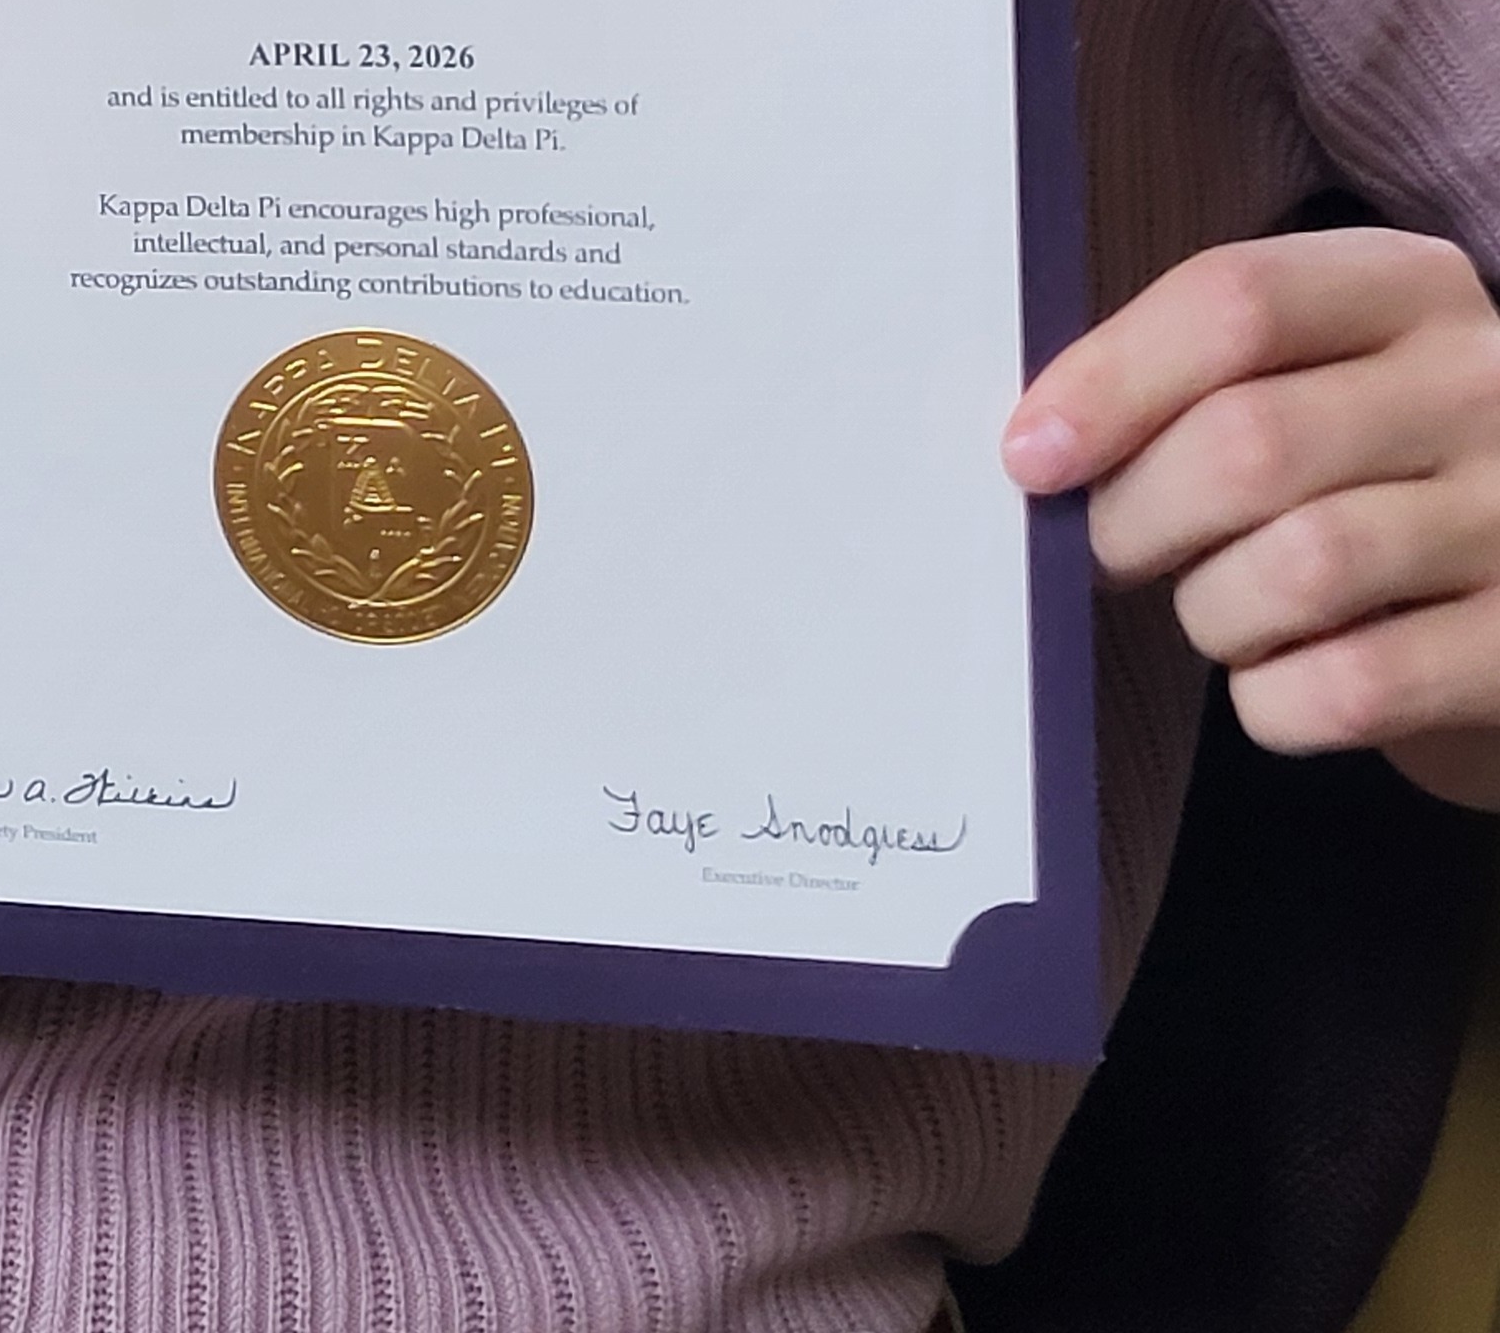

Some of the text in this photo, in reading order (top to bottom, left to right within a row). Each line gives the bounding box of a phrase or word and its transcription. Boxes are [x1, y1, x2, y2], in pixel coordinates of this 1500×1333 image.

[249, 42, 475, 73] APRIL 23, 2026
[107, 84, 640, 122] and is entitled to all rights and privileges of
[181, 121, 566, 156] membership in Kappa Delta Pi.
[99, 193, 656, 232] Kappa Delta Pi encourages high professional,
[133, 230, 622, 265] intellectual, and personal standards and
[70, 268, 690, 305] recognizes outstanding contributions to education.
[22, 823, 98, 845] President
[602, 785, 968, 866] Faye Snodgress
[701, 866, 861, 892] Executive Director
